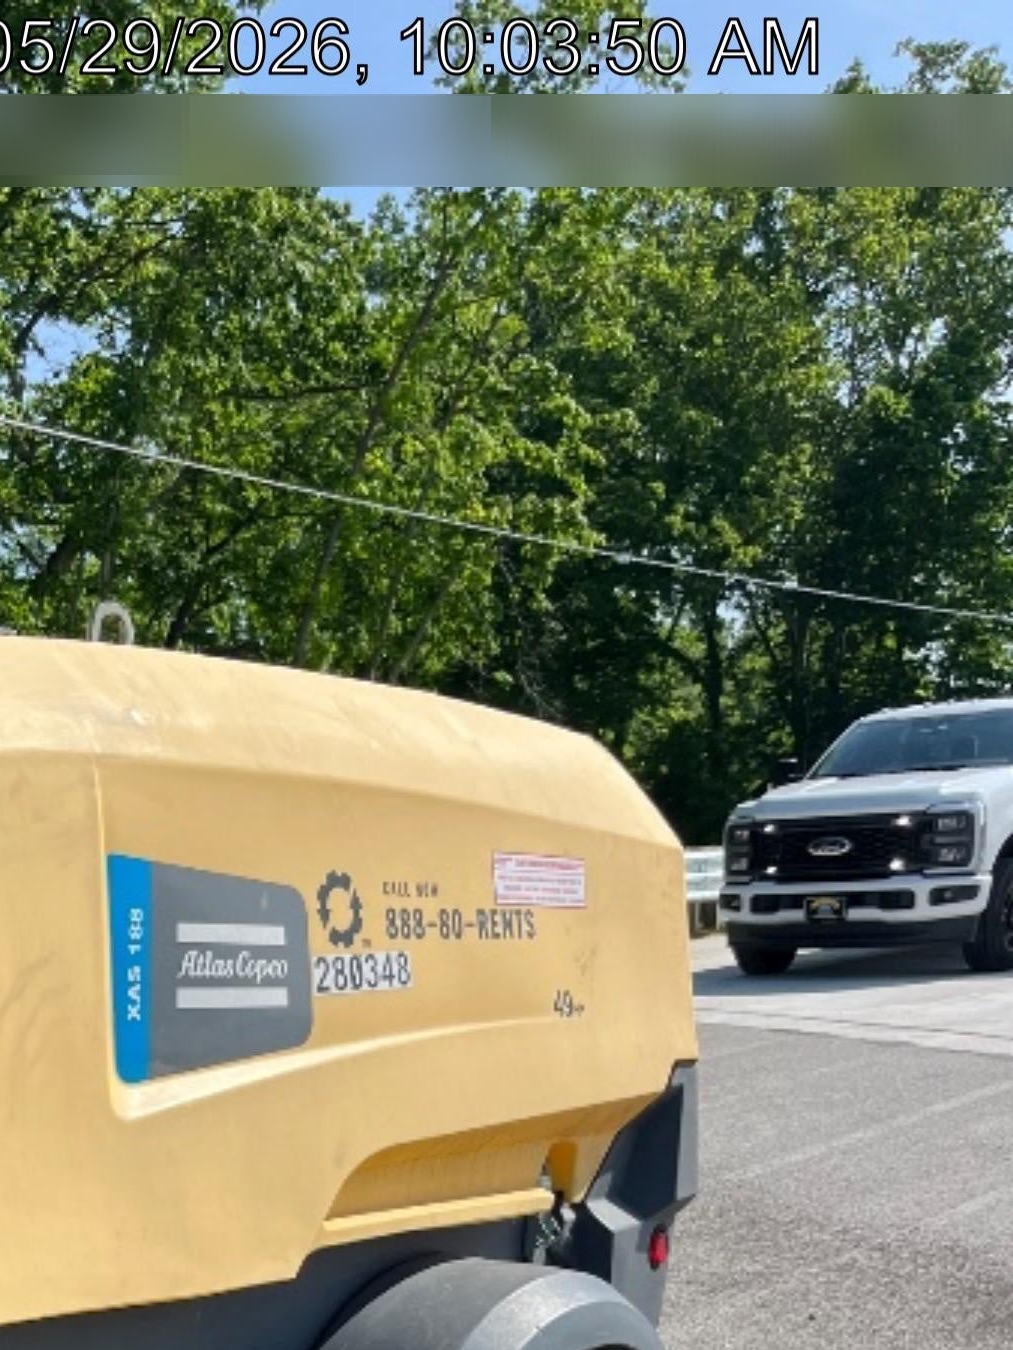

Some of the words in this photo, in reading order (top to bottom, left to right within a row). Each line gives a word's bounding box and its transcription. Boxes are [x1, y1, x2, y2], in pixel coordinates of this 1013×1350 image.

[128, 908, 144, 955] 188
[385, 907, 537, 940] 888-80-RENTS
[176, 950, 234, 979] Atlas
[237, 950, 288, 985] Copco
[315, 951, 411, 993] 280348
[127, 966, 142, 1021] XAS
